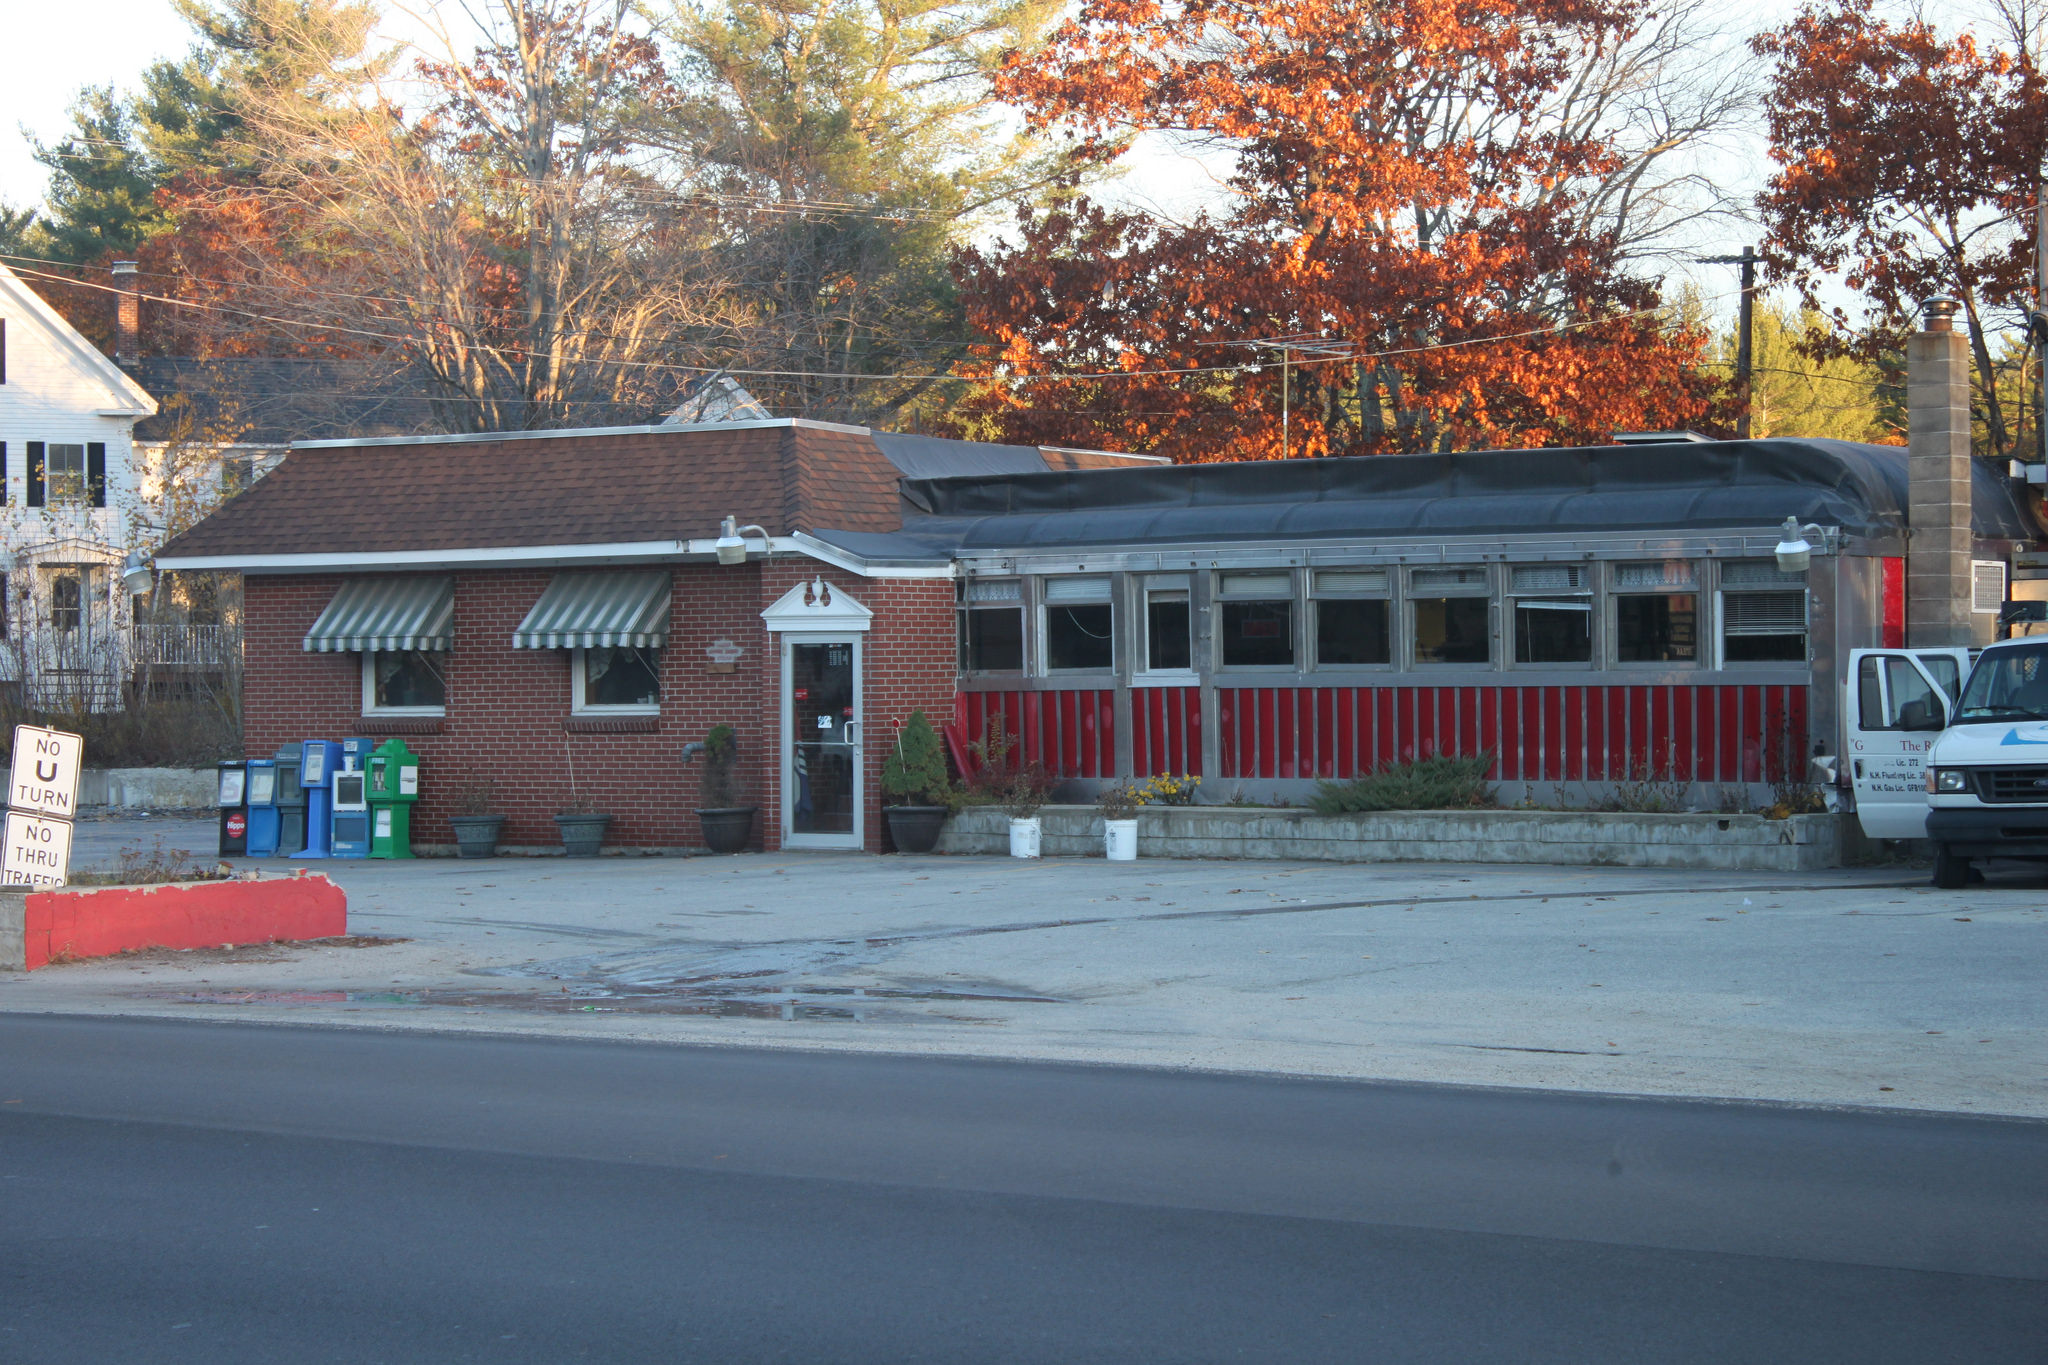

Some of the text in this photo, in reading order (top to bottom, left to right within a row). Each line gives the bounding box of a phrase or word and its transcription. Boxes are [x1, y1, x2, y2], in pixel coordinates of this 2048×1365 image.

[36, 738, 61, 757] NO
[1900, 740, 1921, 752] The
[35, 760, 58, 783] U
[18, 784, 69, 808] TURN
[25, 824, 52, 843] NO
[15, 846, 58, 868] THRU
